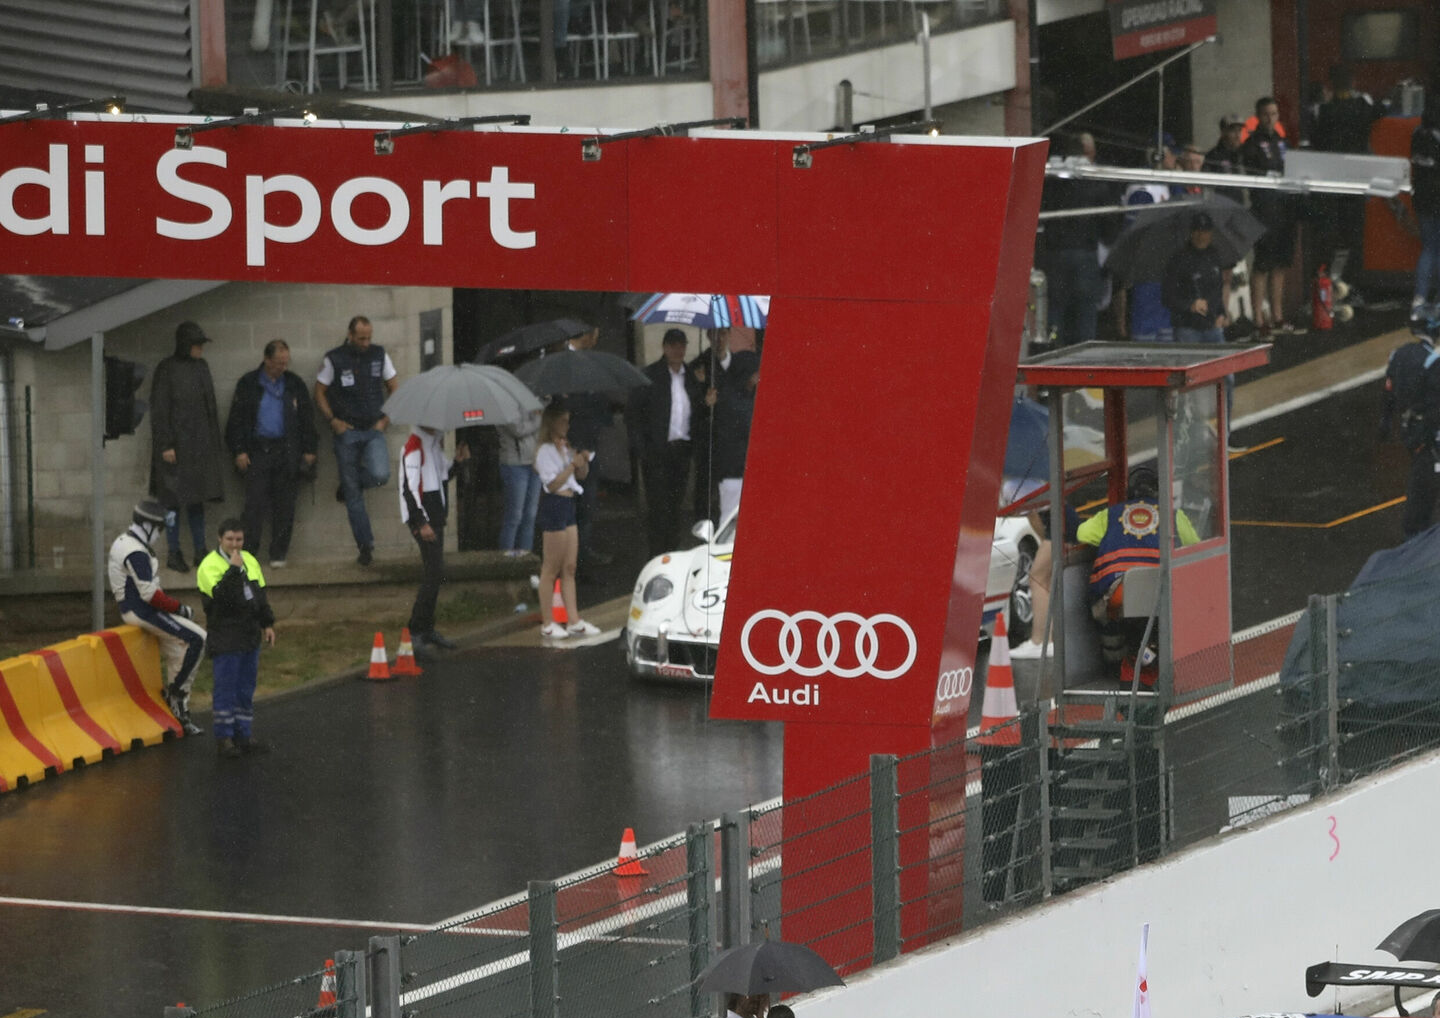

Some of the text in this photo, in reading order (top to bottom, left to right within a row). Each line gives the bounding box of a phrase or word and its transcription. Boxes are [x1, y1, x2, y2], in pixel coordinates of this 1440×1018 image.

[156, 146, 536, 266] Sport
[747, 682, 819, 705] Audi
[1340, 969, 1422, 982] SMP
